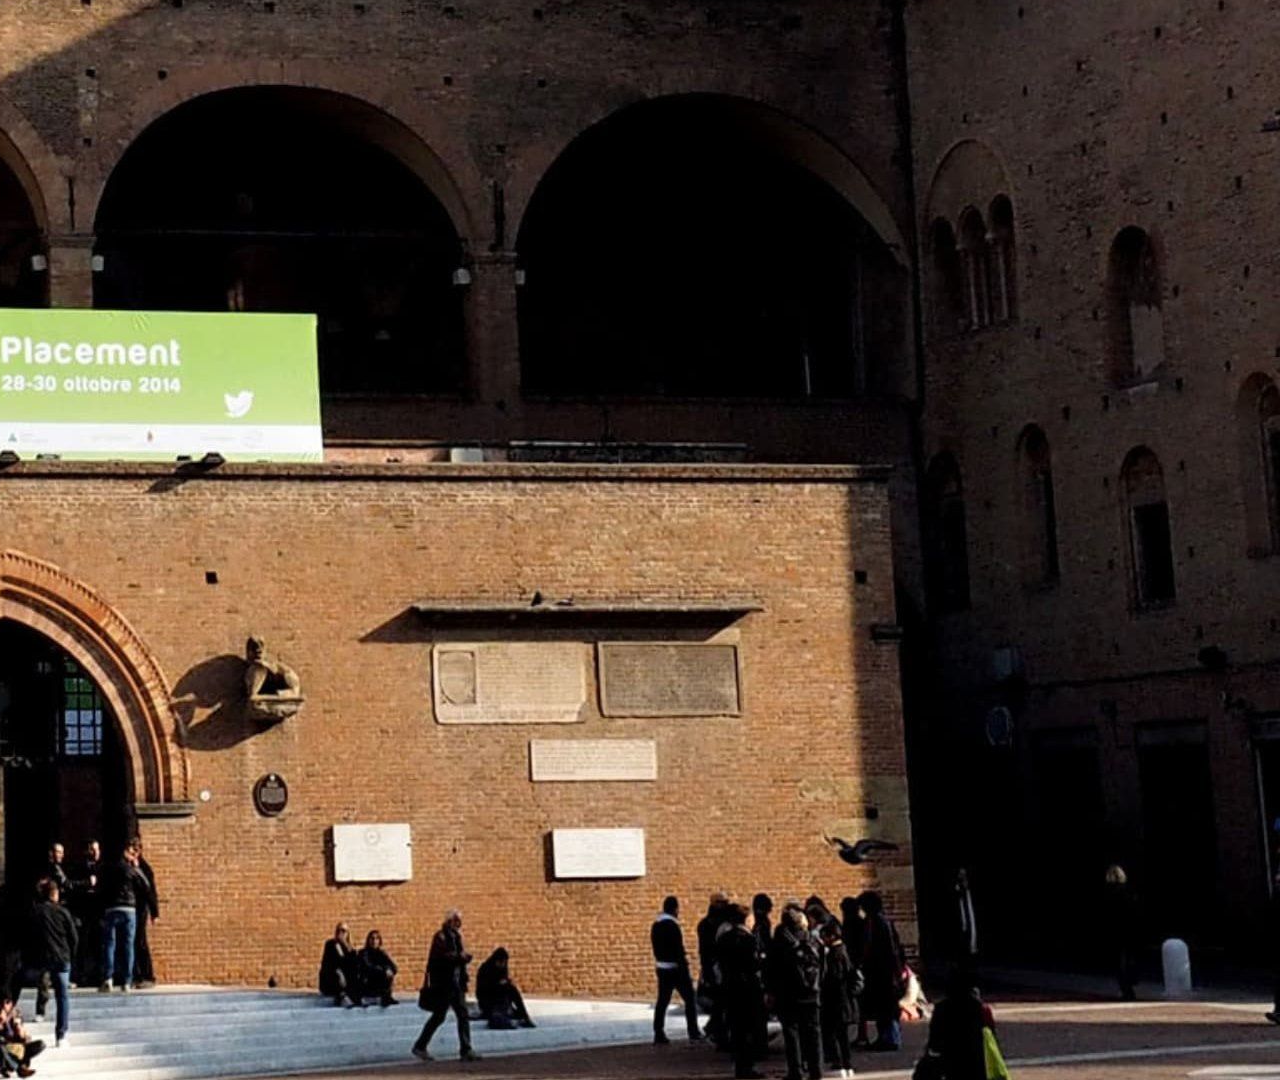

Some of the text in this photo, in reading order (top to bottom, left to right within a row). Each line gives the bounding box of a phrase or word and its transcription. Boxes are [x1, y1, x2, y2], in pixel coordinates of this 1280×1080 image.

[1, 336, 181, 366] Placement
[1, 375, 181, 393] 28-30 ottobre 2014
